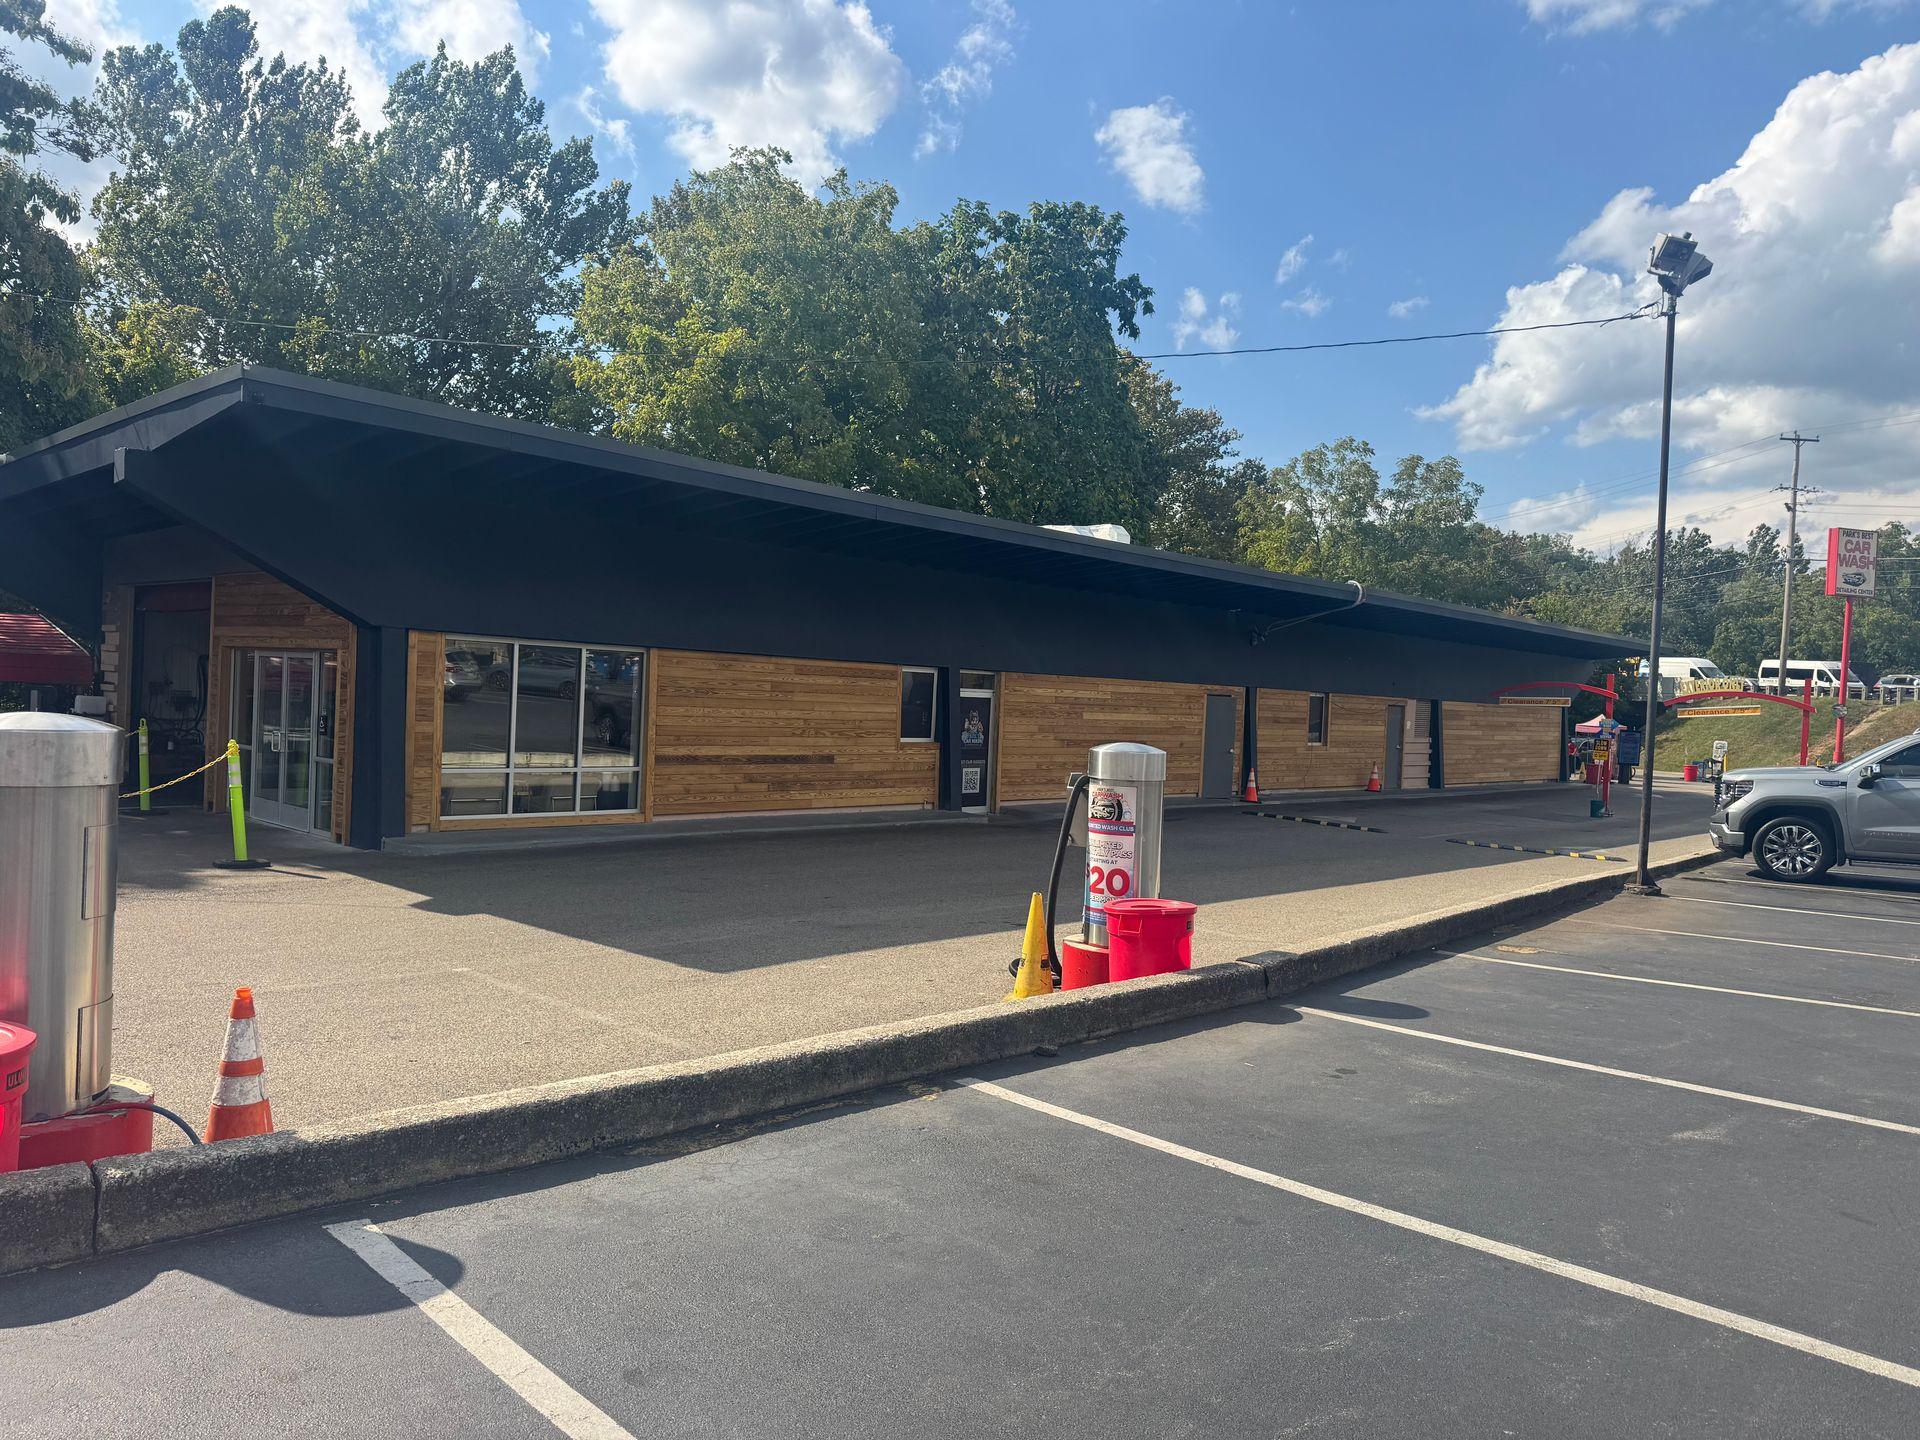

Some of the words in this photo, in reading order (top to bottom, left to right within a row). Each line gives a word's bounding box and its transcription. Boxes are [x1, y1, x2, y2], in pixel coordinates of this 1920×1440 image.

[1842, 530, 1860, 539] PARK'S
[1862, 532, 1873, 540] BEST
[1844, 539, 1871, 555] CAR
[1838, 553, 1876, 570] WASH
